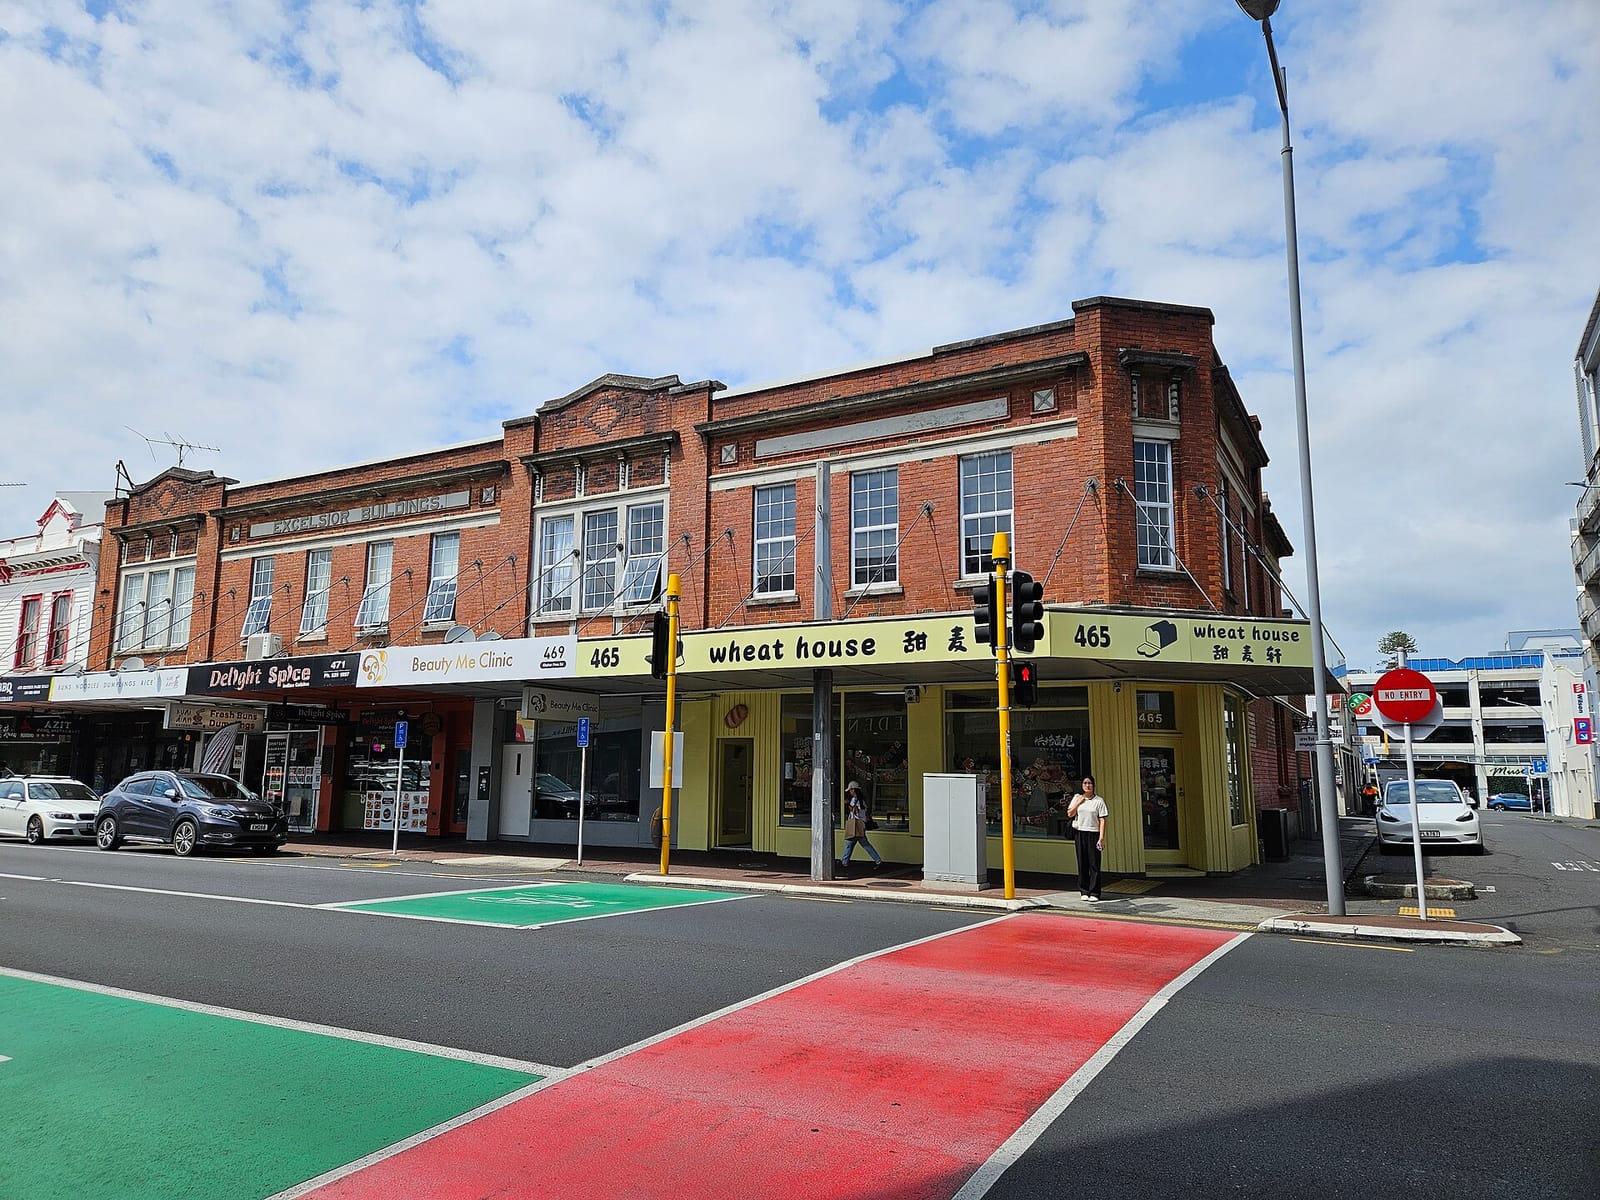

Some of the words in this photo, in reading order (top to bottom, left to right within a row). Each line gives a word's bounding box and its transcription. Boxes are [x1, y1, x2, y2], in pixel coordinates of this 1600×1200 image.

[272, 510, 350, 534] EXCELSIOR
[1074, 624, 1111, 648] 465
[1193, 623, 1245, 640] wheat
[1252, 626, 1300, 642] house
[543, 645, 565, 659] 469
[709, 638, 785, 664] wheat
[796, 635, 876, 660] house
[330, 660, 346, 669] 471
[412, 656, 452, 675] Beauty
[455, 655, 476, 670] Me
[479, 651, 513, 669] Clinic
[590, 647, 620, 668] 465
[209, 666, 262, 690] Delight
[268, 663, 311, 687] Spice
[1350, 694, 1364, 707] OFF
[1384, 691, 1395, 700] NO
[1399, 691, 1423, 700] ENTRY
[550, 699, 570, 712] Beauty
[572, 701, 582, 711] Me
[582, 702, 598, 713] Clinic
[1358, 702, 1371, 712] ON
[236, 711, 257, 720] Buns
[1138, 713, 1163, 723] 465
[44, 721, 72, 729] AZIT
